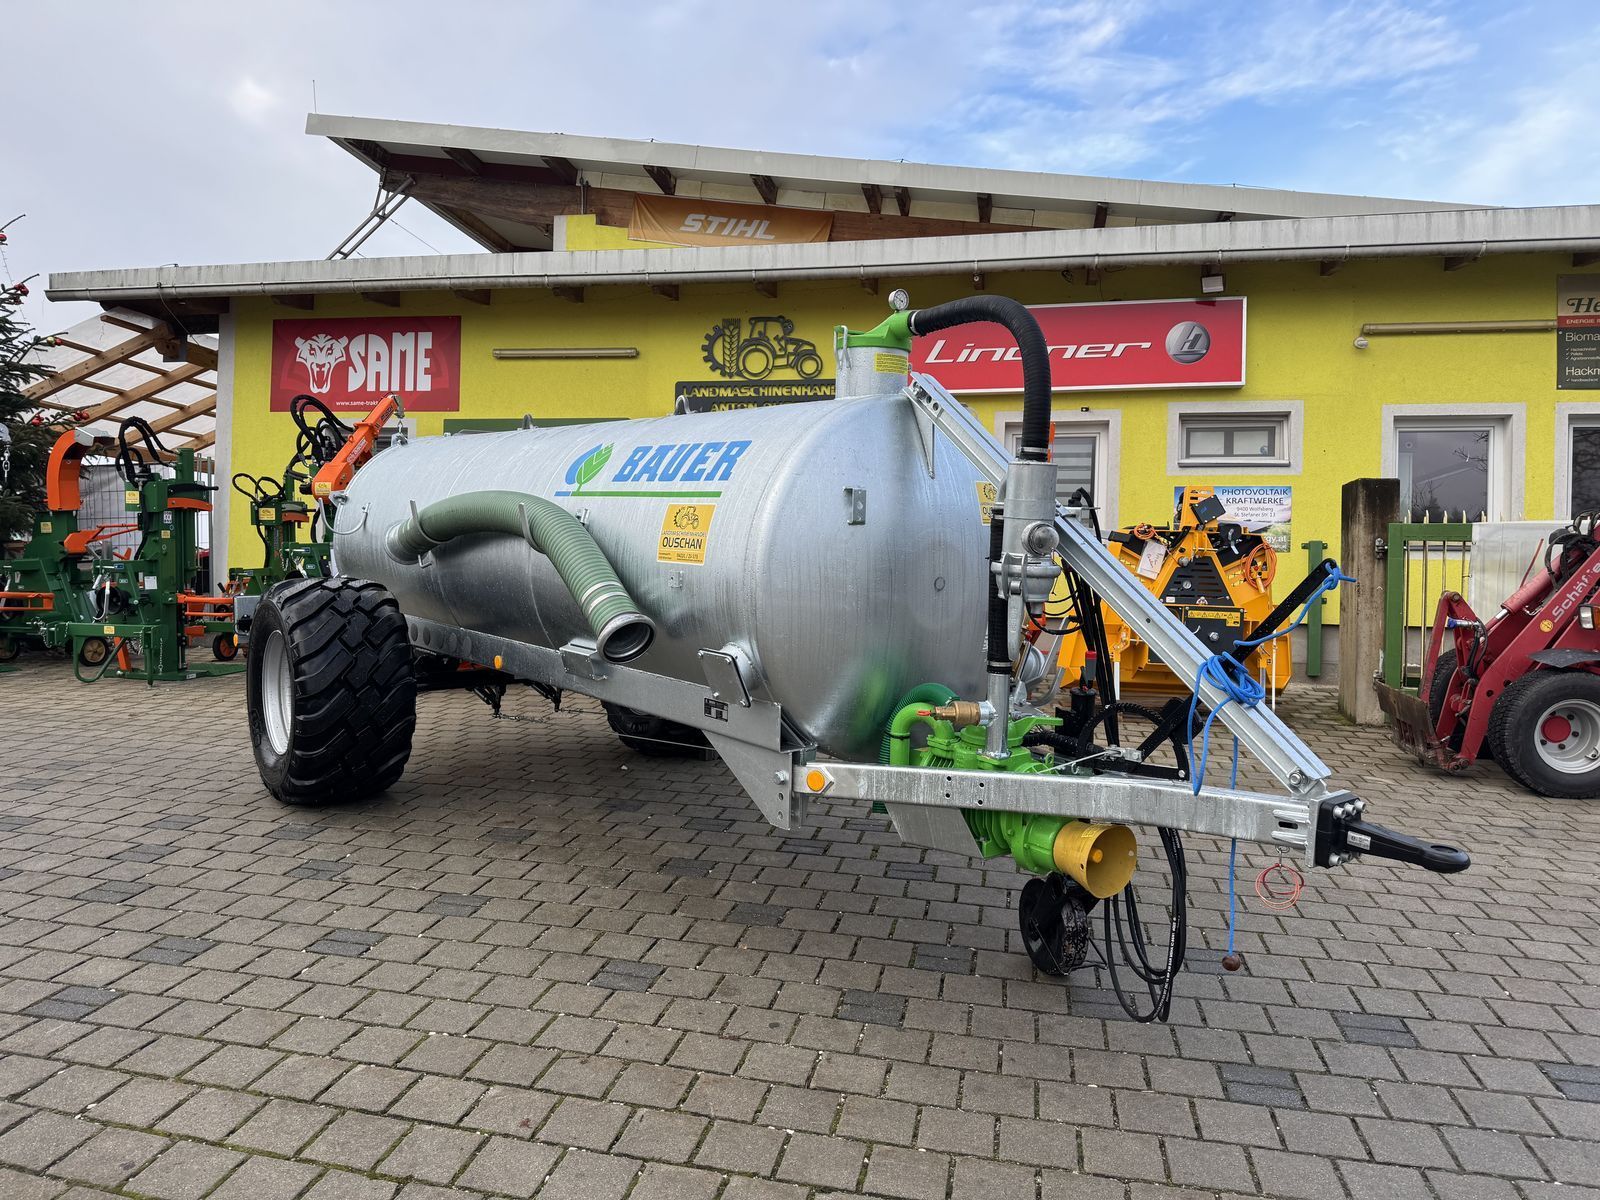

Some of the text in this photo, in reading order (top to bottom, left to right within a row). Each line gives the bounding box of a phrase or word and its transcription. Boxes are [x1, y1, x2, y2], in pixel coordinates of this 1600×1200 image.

[679, 213, 776, 240] STIHL
[347, 331, 433, 393] SAME
[612, 440, 752, 482] BAUER
[1221, 488, 1289, 496] PHOTOVOLTAIK
[1225, 497, 1284, 505] KRAFTWERKE
[662, 536, 703, 550] OUSCHAN
